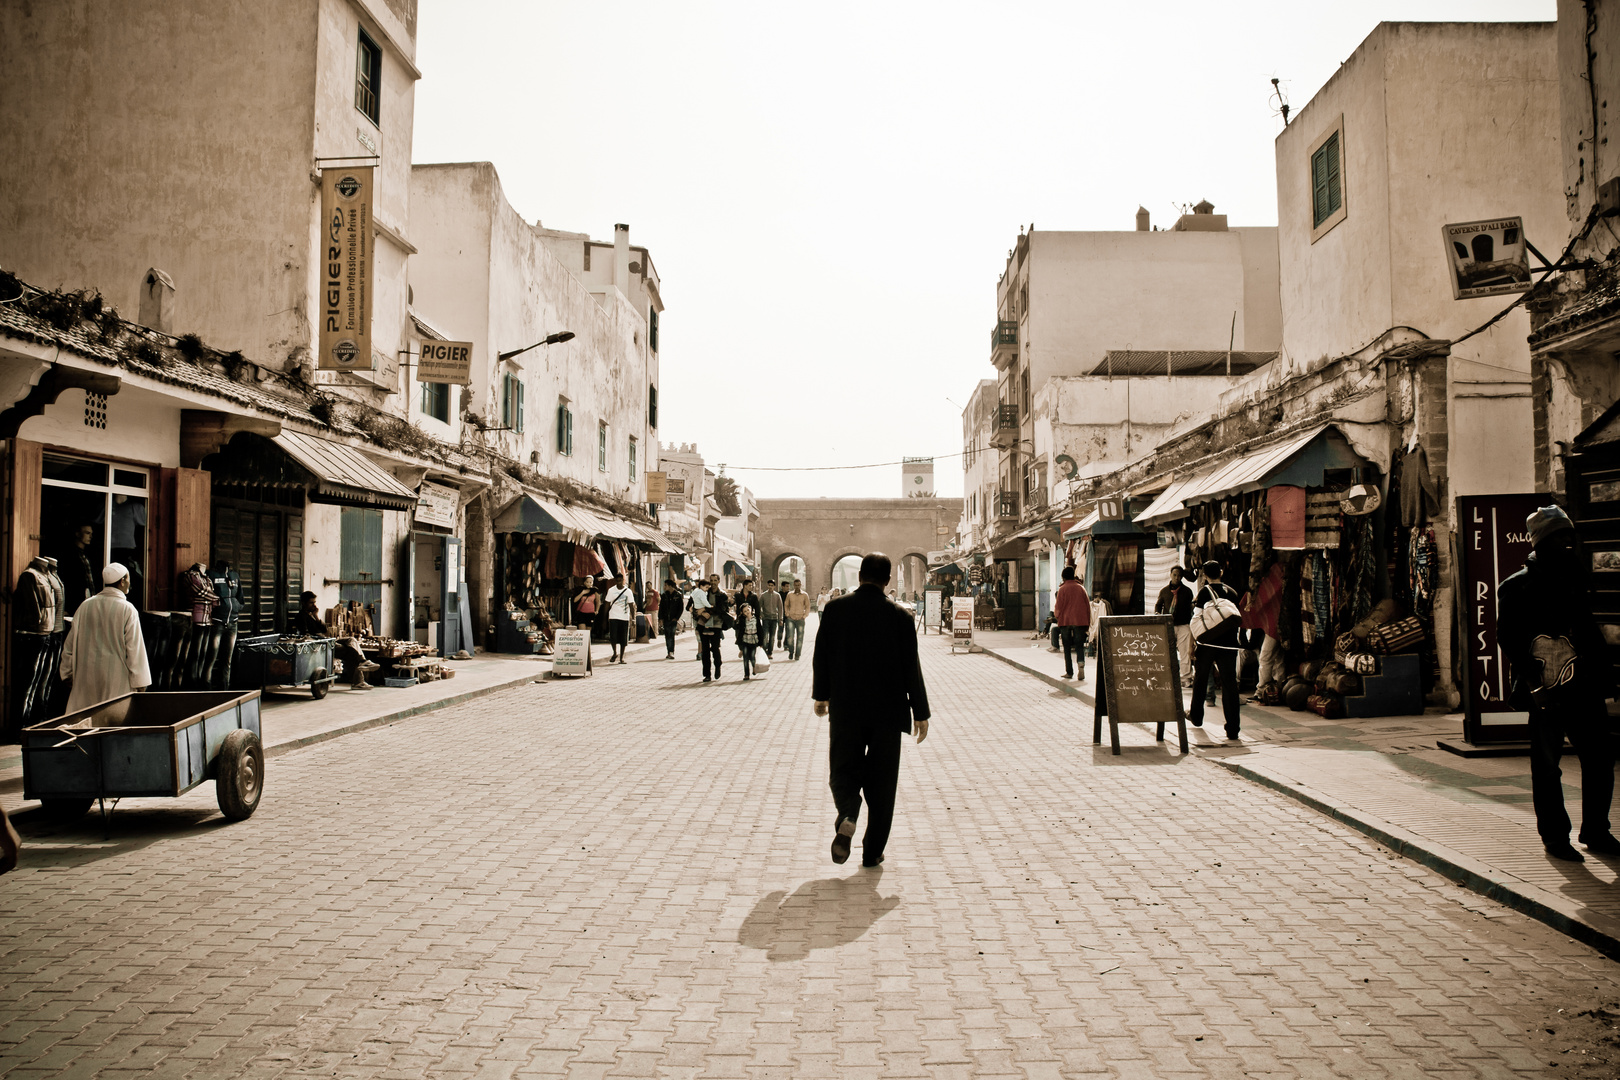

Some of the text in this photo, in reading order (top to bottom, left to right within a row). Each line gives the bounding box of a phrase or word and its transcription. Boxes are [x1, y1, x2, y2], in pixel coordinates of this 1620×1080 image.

[1450, 220, 1518, 236] CAVERNE D'ALI BABA
[346, 234, 356, 291] Professionnelle
[327, 246, 342, 333] PIGIER
[346, 292, 355, 330] Formation
[422, 344, 468, 362] PIGIER
[1473, 506, 1484, 550] LE
[1506, 532, 1532, 544] SALO
[1476, 581, 1492, 701] RESTO
